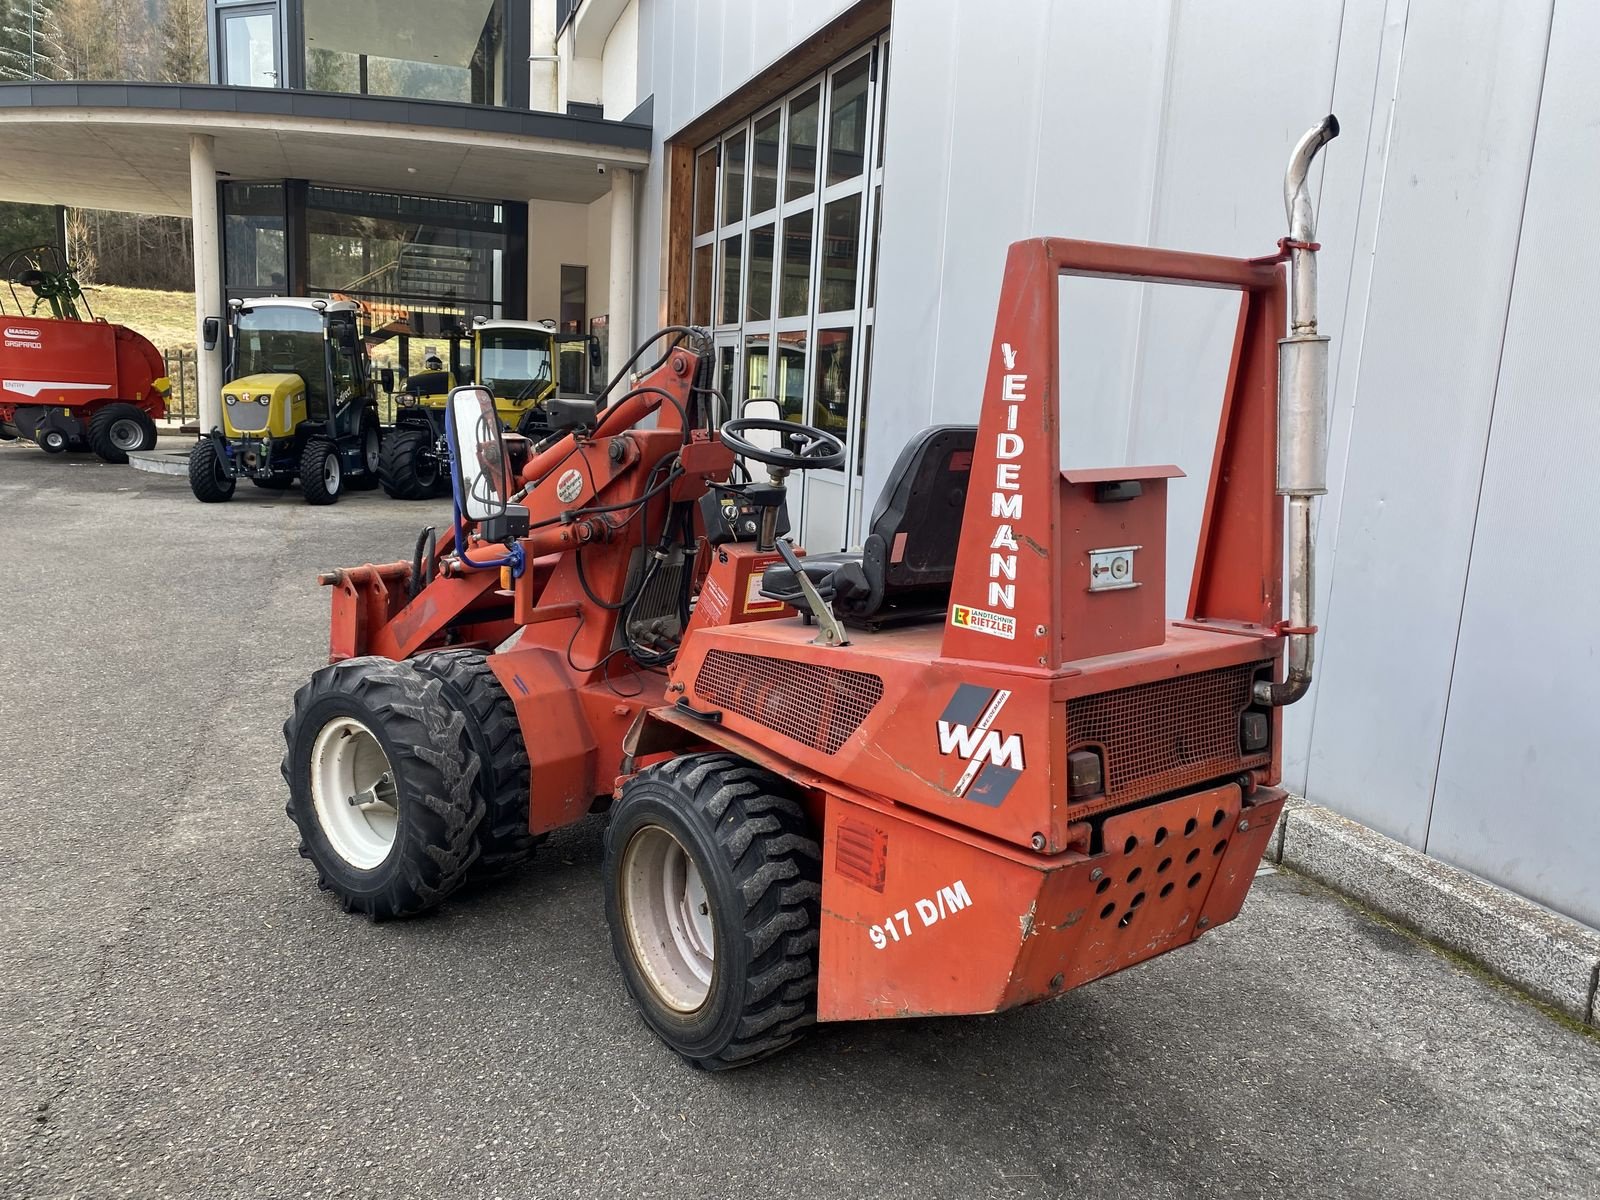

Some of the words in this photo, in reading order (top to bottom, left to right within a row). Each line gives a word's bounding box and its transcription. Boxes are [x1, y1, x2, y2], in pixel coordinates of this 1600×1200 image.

[8, 328, 40, 336] MASCHIO
[4, 340, 42, 349] GASPARDO
[971, 609, 1014, 624] LANDTECHNIK
[970, 616, 1014, 634] RIETZLER
[982, 691, 1007, 728] WEIDEMANN
[869, 908, 912, 950] 917
[914, 879, 973, 927] D/M
